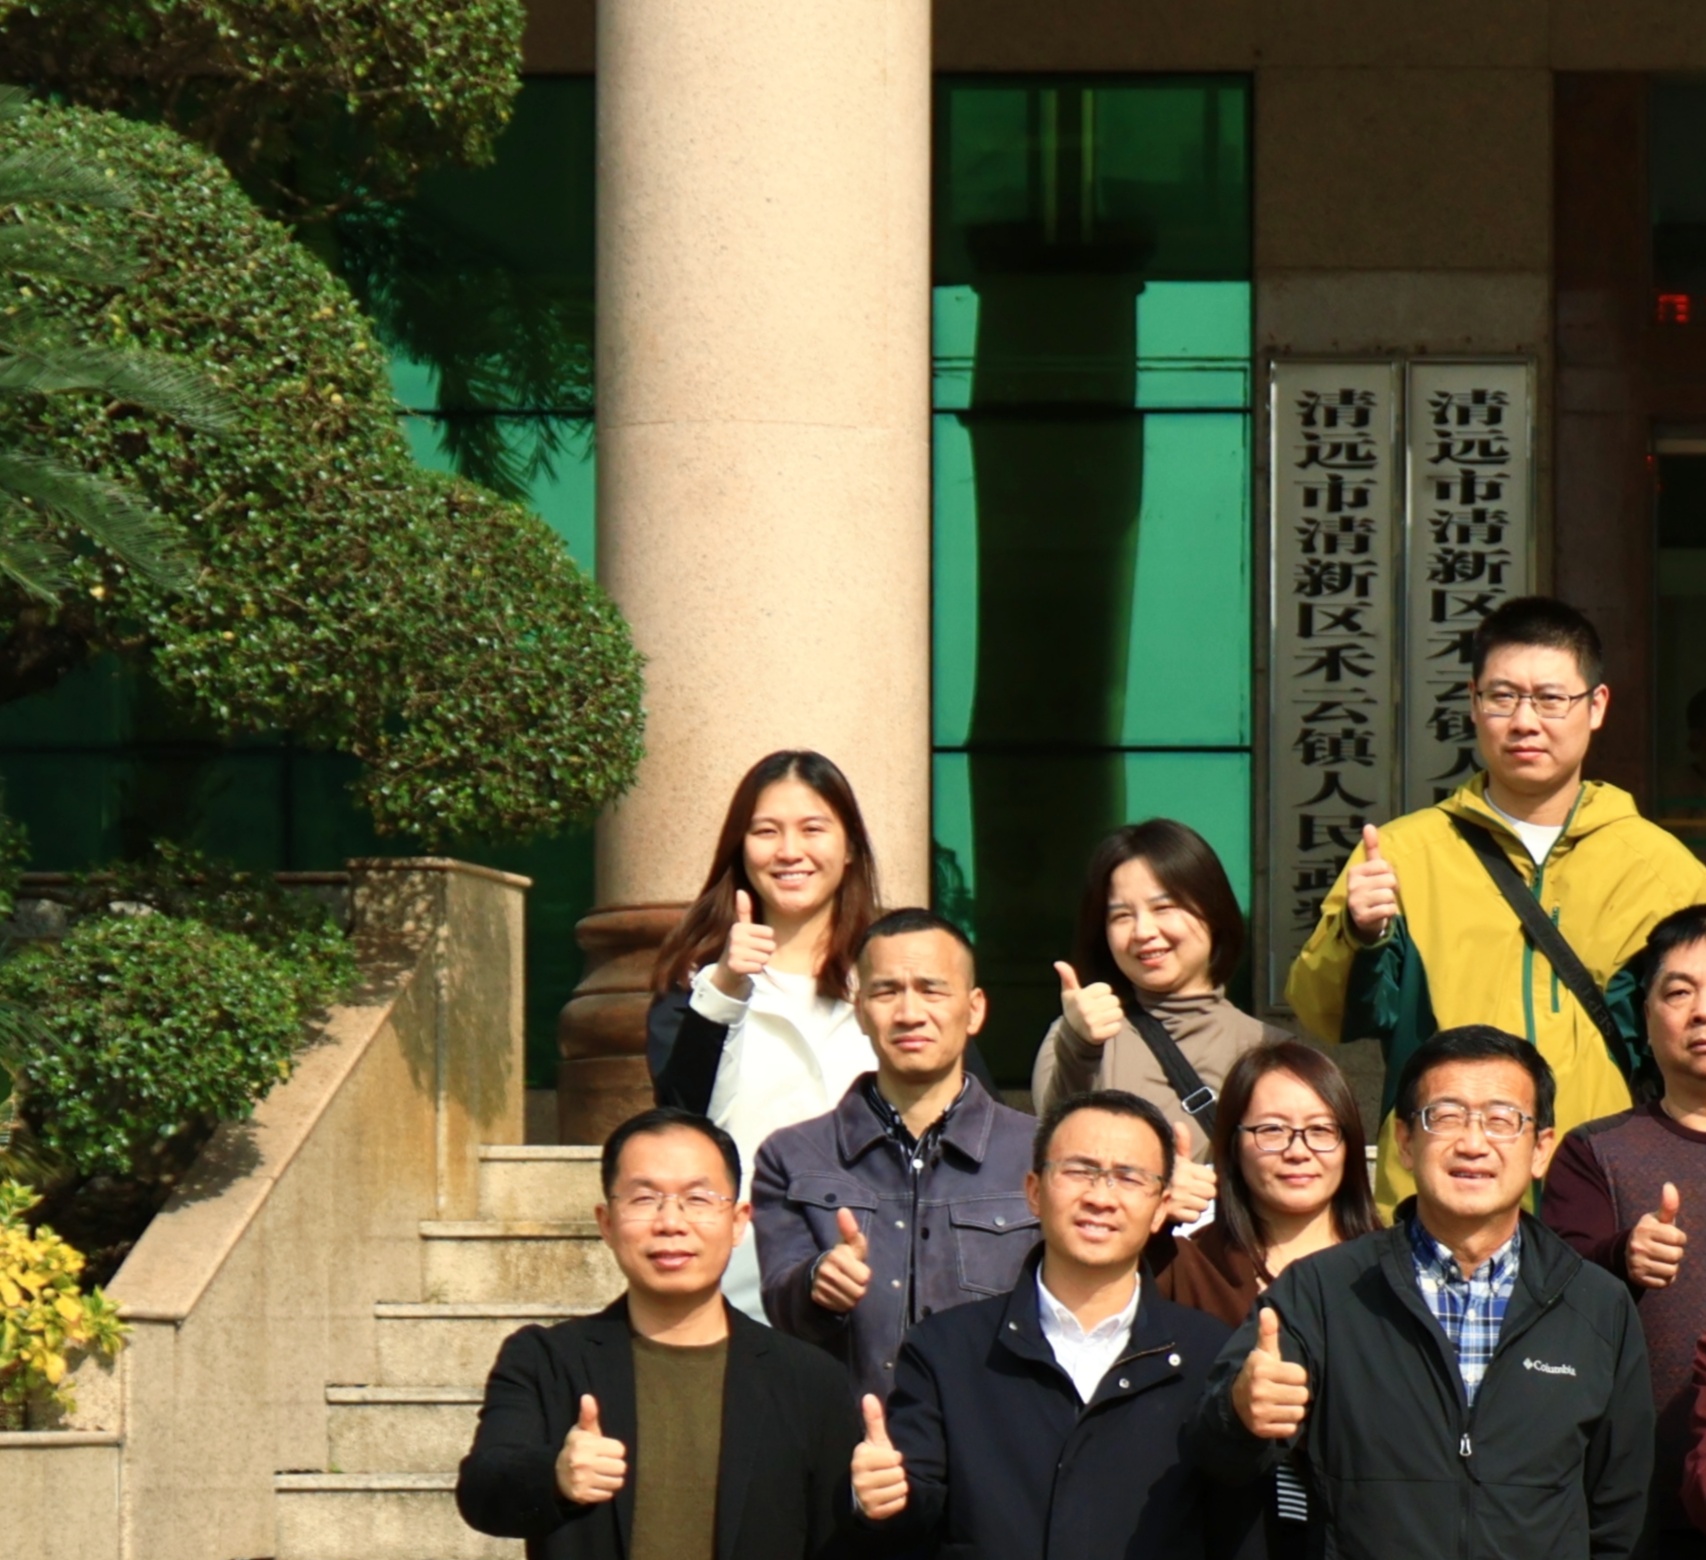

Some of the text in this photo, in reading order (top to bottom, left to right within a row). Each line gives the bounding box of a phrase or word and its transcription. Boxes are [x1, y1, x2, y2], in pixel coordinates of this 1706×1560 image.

[1426, 388, 1511, 803] 清远市清新区禾云镇人
[1532, 1359, 1577, 1377] Columbia
